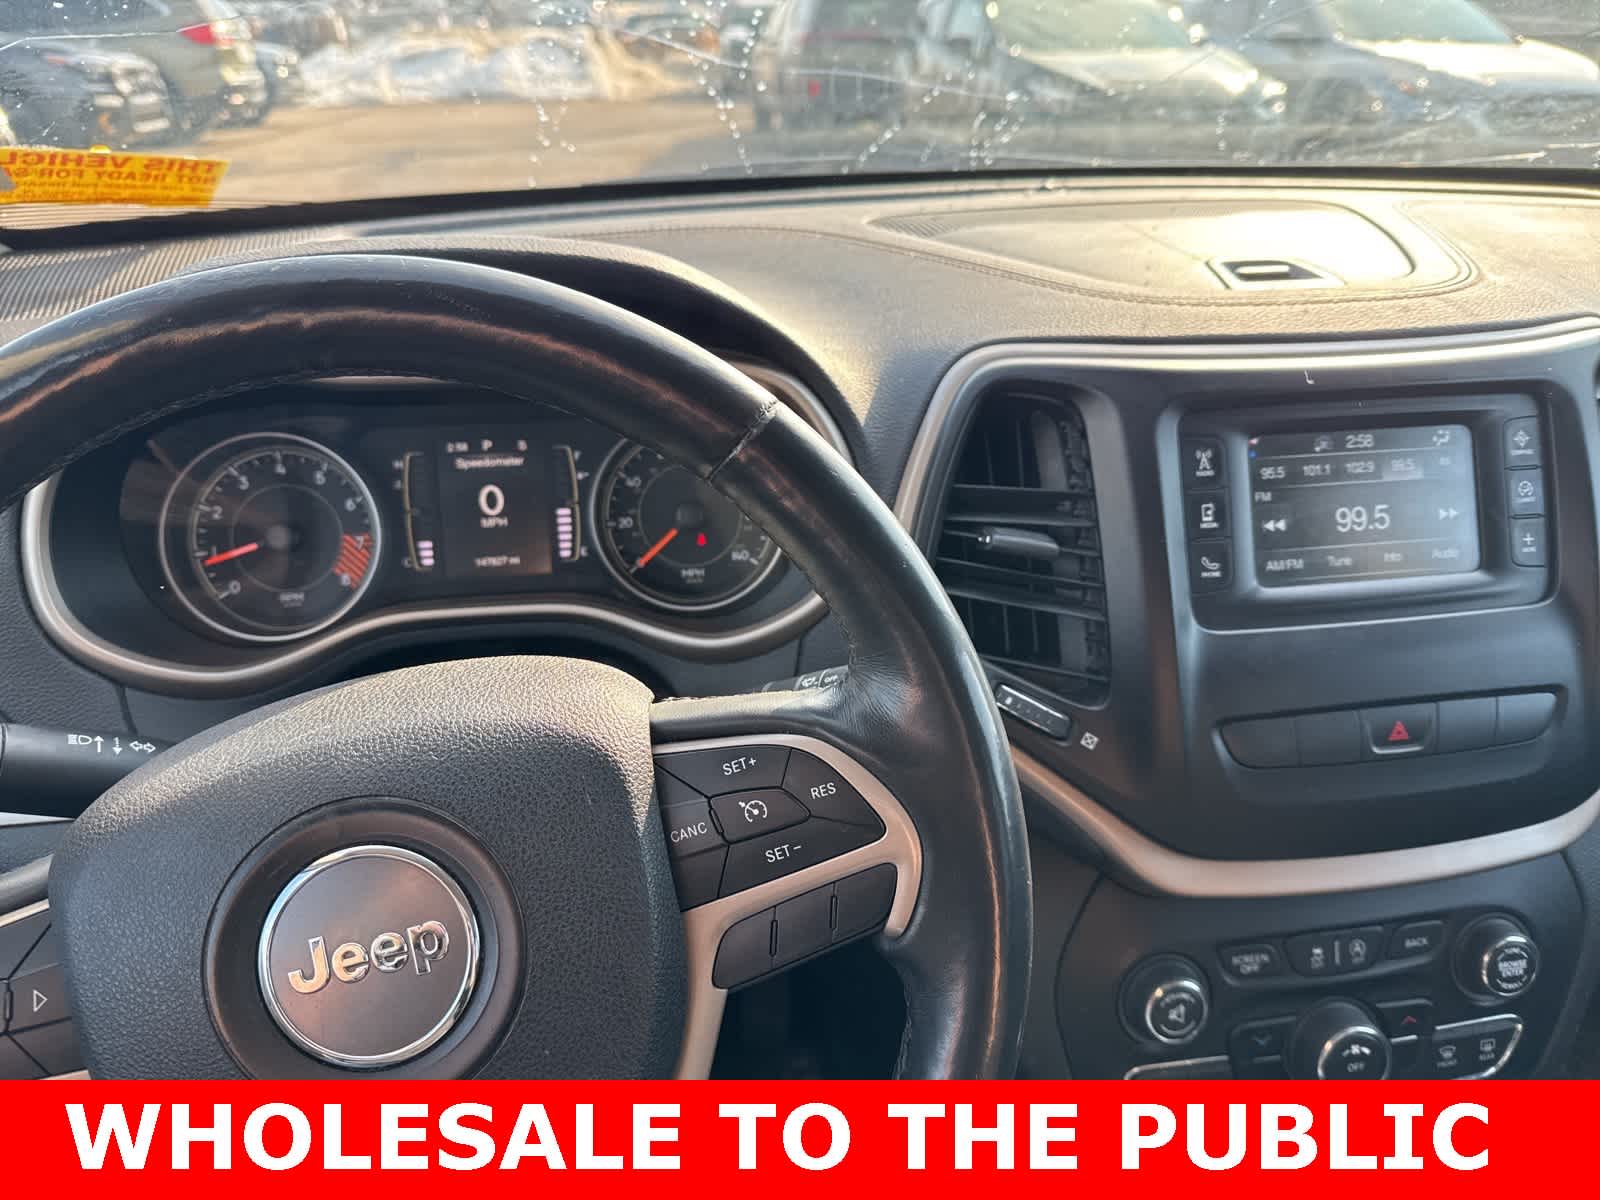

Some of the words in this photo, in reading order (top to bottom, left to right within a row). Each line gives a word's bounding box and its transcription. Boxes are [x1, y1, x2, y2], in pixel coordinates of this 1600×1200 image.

[481, 439, 493, 451] P
[274, 462, 287, 476] 4
[455, 455, 525, 472] Speedometer
[1302, 463, 1332, 477] 101.1
[239, 476, 250, 491] 3
[315, 470, 326, 486] 5
[478, 484, 505, 517] 0
[1254, 491, 1273, 502] FM
[344, 498, 356, 512] 6
[212, 505, 223, 521] 2
[1335, 504, 1391, 533] 99.5
[617, 516, 633, 530] 20
[229, 580, 241, 595] 0
[810, 782, 837, 801] RES
[670, 822, 708, 844] CANC
[1404, 936, 1429, 949] BACK
[287, 920, 451, 994] Jeep
